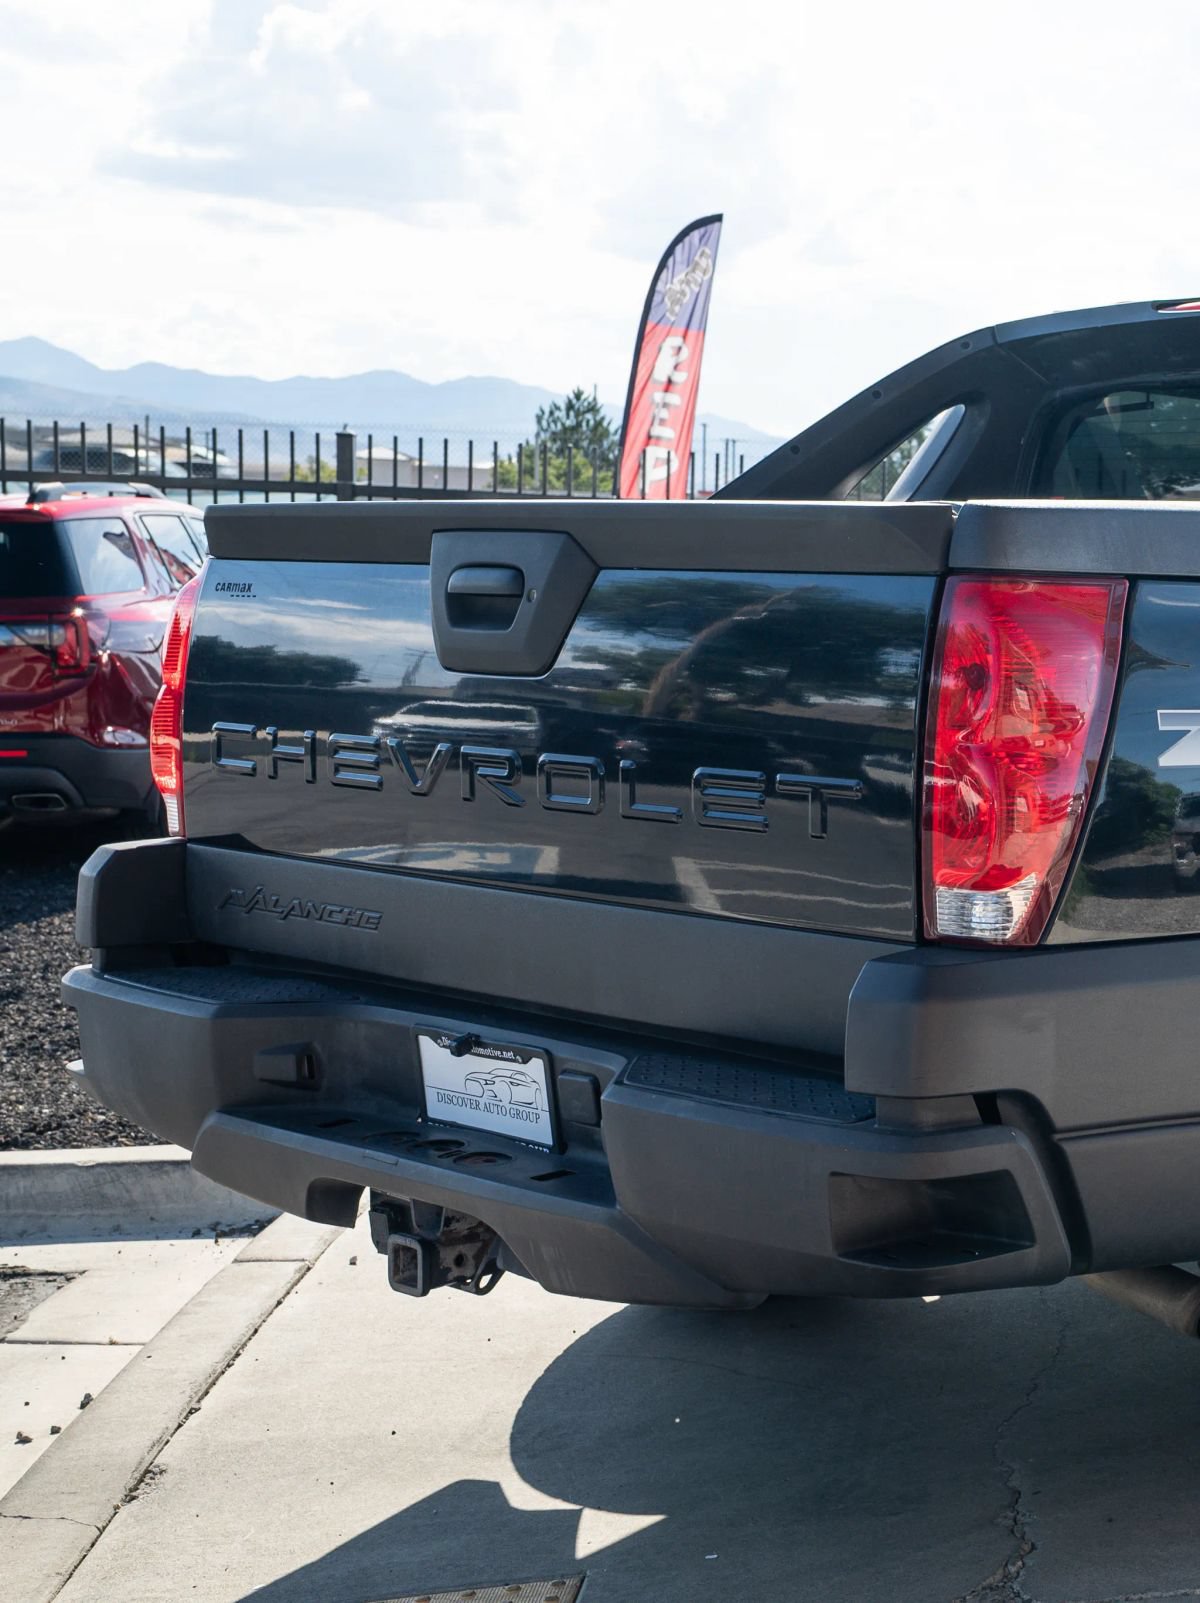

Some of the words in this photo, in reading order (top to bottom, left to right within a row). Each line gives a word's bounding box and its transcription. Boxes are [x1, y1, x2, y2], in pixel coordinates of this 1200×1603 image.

[210, 721, 865, 841] CHEVROLET
[218, 884, 383, 933] AVALANCHE
[437, 1091, 482, 1112] DISCOVER
[483, 1103, 508, 1117] AUTO
[509, 1106, 541, 1124] GROUP
